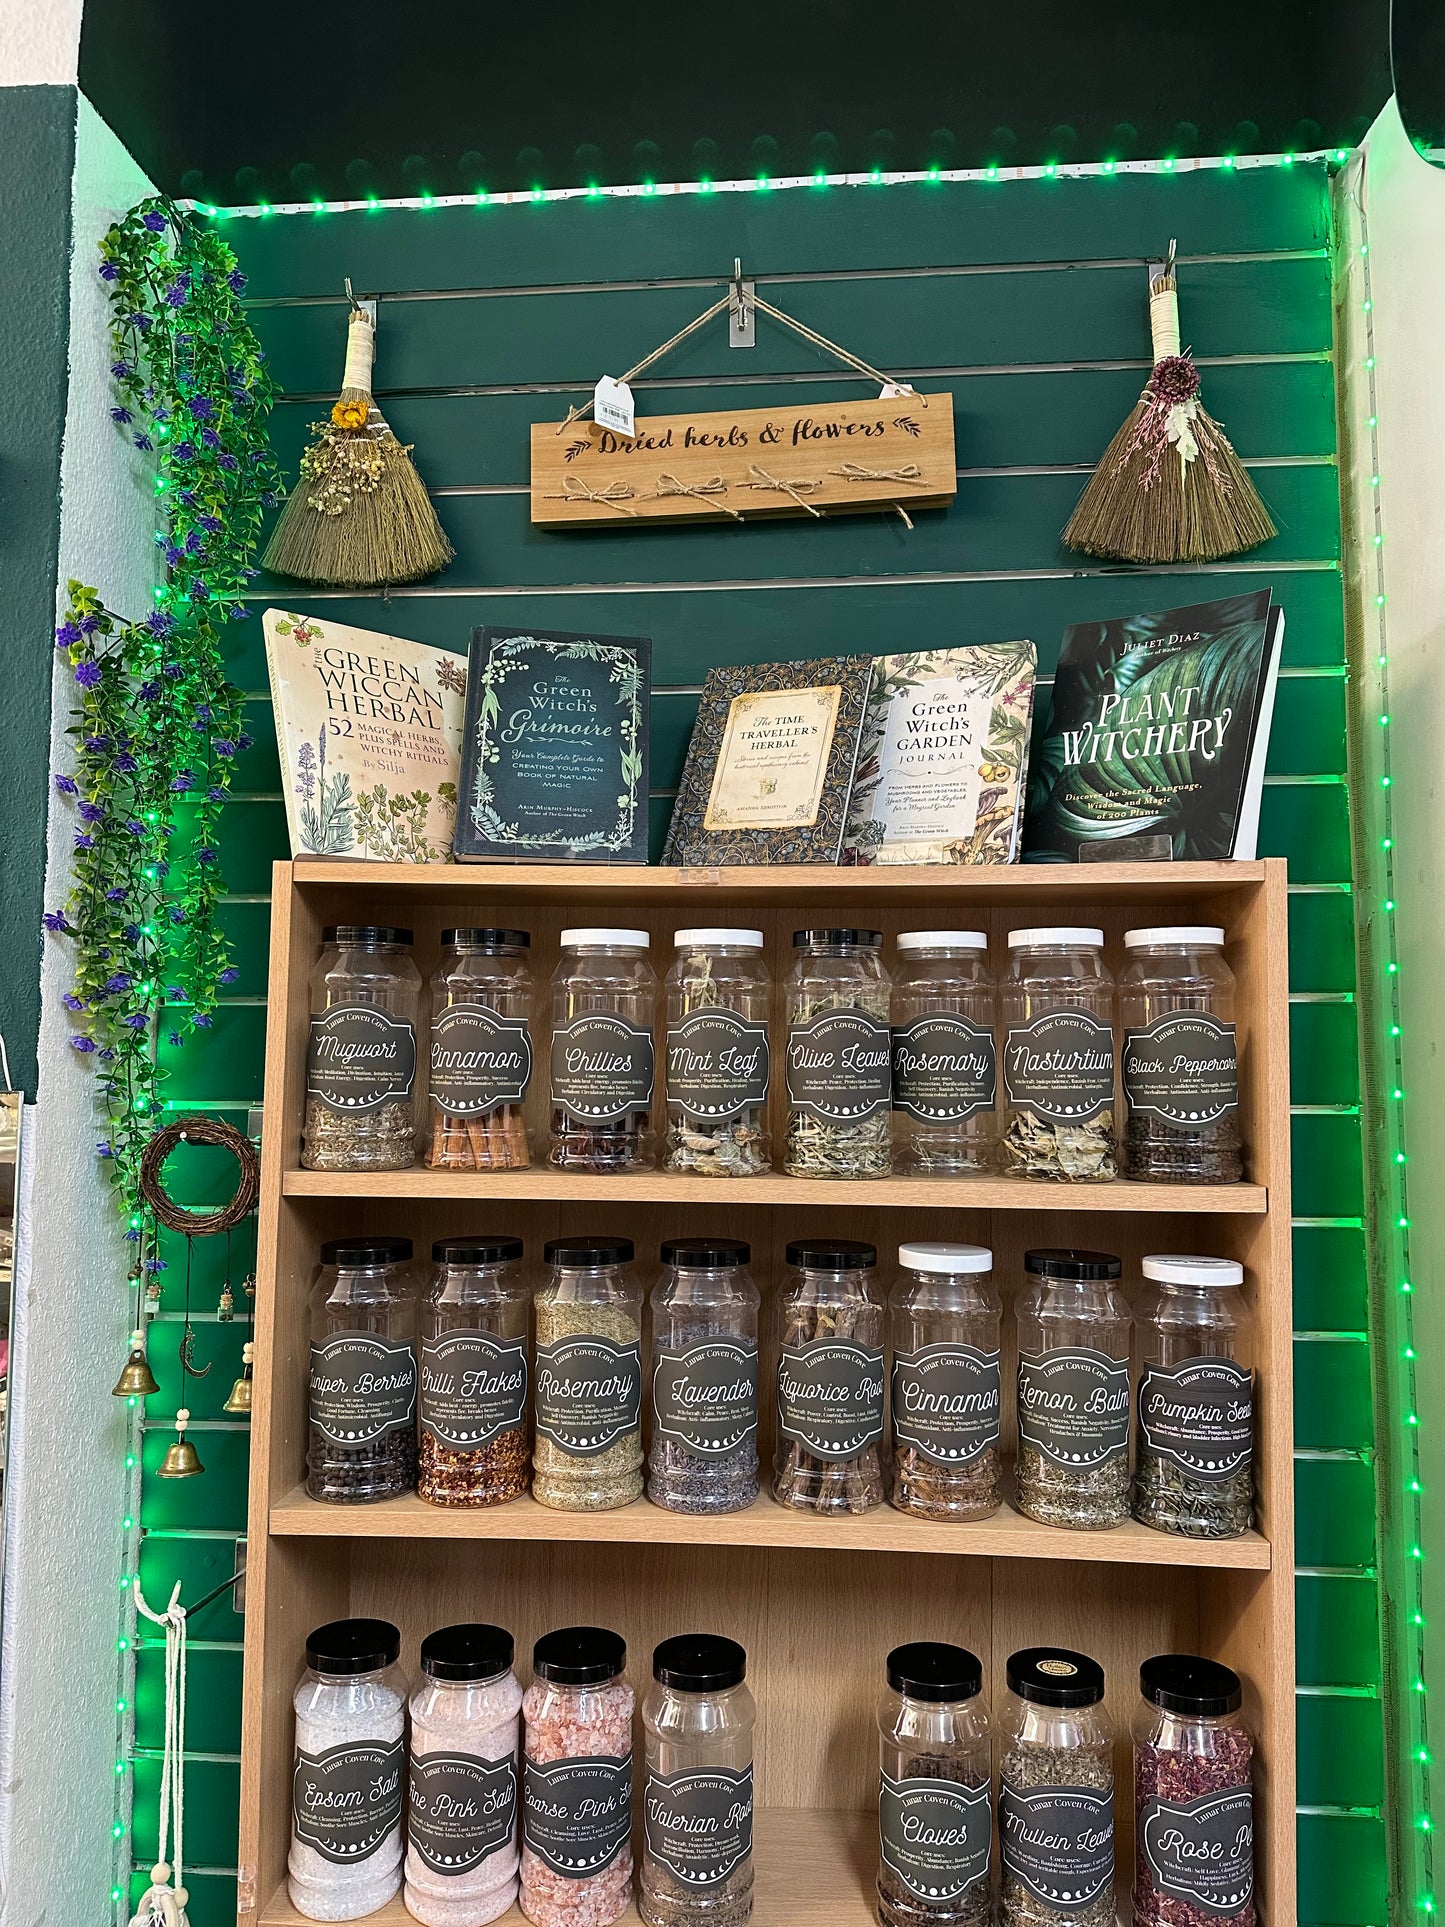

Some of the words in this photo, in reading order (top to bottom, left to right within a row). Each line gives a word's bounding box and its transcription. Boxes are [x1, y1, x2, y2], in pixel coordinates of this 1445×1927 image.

[598, 430, 673, 454] Dried
[685, 426, 749, 449] herbs
[759, 423, 784, 443] &
[792, 418, 885, 446] flowers
[1120, 641, 1164, 655] JULIET
[1168, 631, 1200, 645] DIAZ
[323, 648, 419, 684] GREEN
[317, 667, 444, 710] WICCAN
[533, 682, 591, 697] Green
[327, 690, 441, 730] HERBAL
[528, 696, 597, 713] Witch's
[912, 703, 968, 717] Green
[1097, 686, 1200, 727] PLANT
[329, 717, 354, 738] 52
[500, 709, 612, 743] Grimoire
[740, 727, 818, 739] TRAVELLER'S
[753, 716, 773, 727] The
[776, 715, 805, 724] TIME
[906, 718, 970, 733] Witch's
[357, 723, 405, 739] MAGICAL
[408, 732, 443, 746] HERBS,
[359, 733, 384, 744] PLUS
[387, 738, 421, 751] SPELLS
[422, 745, 445, 755] AND
[751, 740, 798, 750] HERBAL
[897, 734, 973, 750] GARDEN
[1062, 708, 1232, 766] WITCHERY
[360, 743, 403, 759] WITCHY
[406, 752, 449, 765] RITUALS
[899, 752, 965, 764] JOURNAL
[363, 760, 375, 770] By
[377, 760, 405, 774] Silja
[1065, 793, 1104, 801] Discover
[1122, 787, 1152, 796] Sacred
[1155, 782, 1203, 793] Language,
[1144, 796, 1171, 805] Magic
[1129, 809, 1159, 817] Plants
[326, 1016, 345, 1031] Lunar
[347, 1014, 370, 1023] Coven
[372, 1017, 388, 1032] Cove
[570, 1025, 588, 1039] Lunar
[590, 1022, 612, 1031] Coven
[614, 1025, 629, 1040] Cove
[813, 1024, 833, 1040] Lunar
[834, 1022, 857, 1030] Coven
[858, 1024, 873, 1038] Cove
[1154, 1028, 1176, 1044] Lunar
[1177, 1024, 1202, 1033] Coven
[1203, 1028, 1220, 1041] Cove
[316, 1035, 397, 1064] Mugwort
[431, 1042, 523, 1070] Cinnamon
[565, 1047, 632, 1073] Chillies
[790, 1044, 836, 1070] Olive
[842, 1043, 890, 1073] Leaves
[1010, 1046, 1113, 1076] Nasturtium
[669, 1046, 713, 1076] Mint
[719, 1046, 760, 1078] Leaf
[894, 1047, 989, 1079] Rosemary
[1127, 1057, 1165, 1074] Black
[324, 1347, 342, 1361] Lunar
[343, 1344, 367, 1353] Coven
[368, 1347, 386, 1360] Cove
[805, 1354, 826, 1369] Lunar
[827, 1351, 850, 1361] Coven
[851, 1355, 867, 1368] Cove
[353, 1371, 413, 1394] Berries
[461, 1370, 522, 1397] Flakes
[538, 1369, 633, 1402] Rosemary
[779, 1371, 850, 1402] Liquorice
[1177, 1372, 1200, 1387] Lunar
[1201, 1370, 1225, 1380] Coven
[1226, 1374, 1240, 1389] Cove
[671, 1376, 754, 1408] Lavender
[902, 1380, 999, 1413] Cinnamon
[1020, 1377, 1077, 1409] Lemon
[1084, 1387, 1128, 1414] Balm
[1148, 1393, 1223, 1425] Pumpkin
[322, 1761, 344, 1775] Lunar
[345, 1755, 369, 1764] Coven
[370, 1754, 385, 1766] Cove
[305, 1781, 364, 1811] Epsom
[370, 1768, 399, 1801] Salt
[431, 1794, 478, 1818] Pink
[484, 1784, 513, 1814] Salt
[574, 1795, 617, 1821] Pink
[648, 1798, 719, 1833] Valerian
[902, 1796, 923, 1807] Lunar
[924, 1794, 949, 1805] Coven
[950, 1800, 967, 1814] Cove
[900, 1811, 968, 1846] Cloves
[1005, 1808, 1072, 1850] Mullein
[1157, 1829, 1224, 1863] Rose
